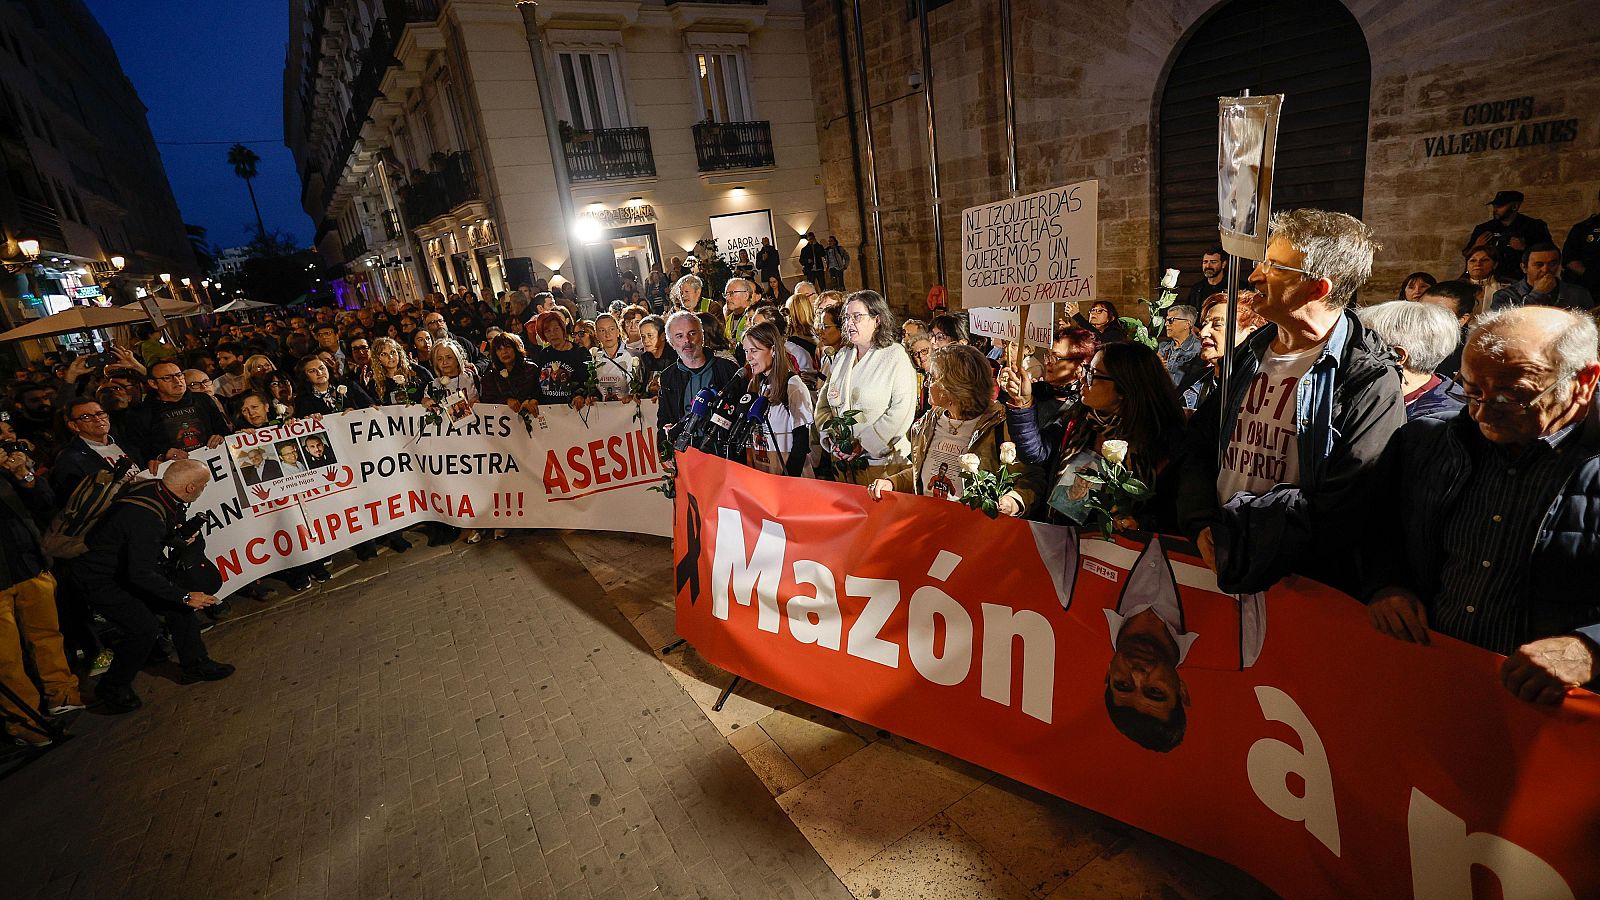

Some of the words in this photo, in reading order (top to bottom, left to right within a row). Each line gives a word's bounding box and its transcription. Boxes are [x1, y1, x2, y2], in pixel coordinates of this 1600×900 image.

[1464, 96, 1535, 126] CORTS
[1424, 118, 1579, 158] VALENCIANES
[966, 209, 982, 231] NI
[985, 187, 1082, 228] IZQUIERDAS
[727, 236, 754, 251] SABOR
[967, 231, 983, 251] NI
[988, 215, 1063, 247] DERECHAS
[965, 241, 1041, 271] QUEREMOS
[1048, 236, 1069, 261] UN
[968, 263, 1038, 288] GOBIERNO
[1048, 258, 1081, 281] QUE
[1240, 371, 1299, 424] 0:1
[232, 419, 325, 450] JUSTICIA
[1247, 420, 1297, 456] OBLIT
[272, 478, 284, 487] por
[285, 474, 294, 482] mi
[294, 470, 318, 480] marido
[543, 427, 664, 494] ASESIN
[205, 497, 244, 537] AN
[360, 452, 413, 483] POR
[415, 452, 520, 476] VUESTRA
[298, 477, 315, 486] hijos
[215, 489, 475, 583] NCOMPETENCIA
[493, 491, 524, 517] !!!
[711, 506, 1056, 725] Mazón
[1246, 685, 1341, 858] a
